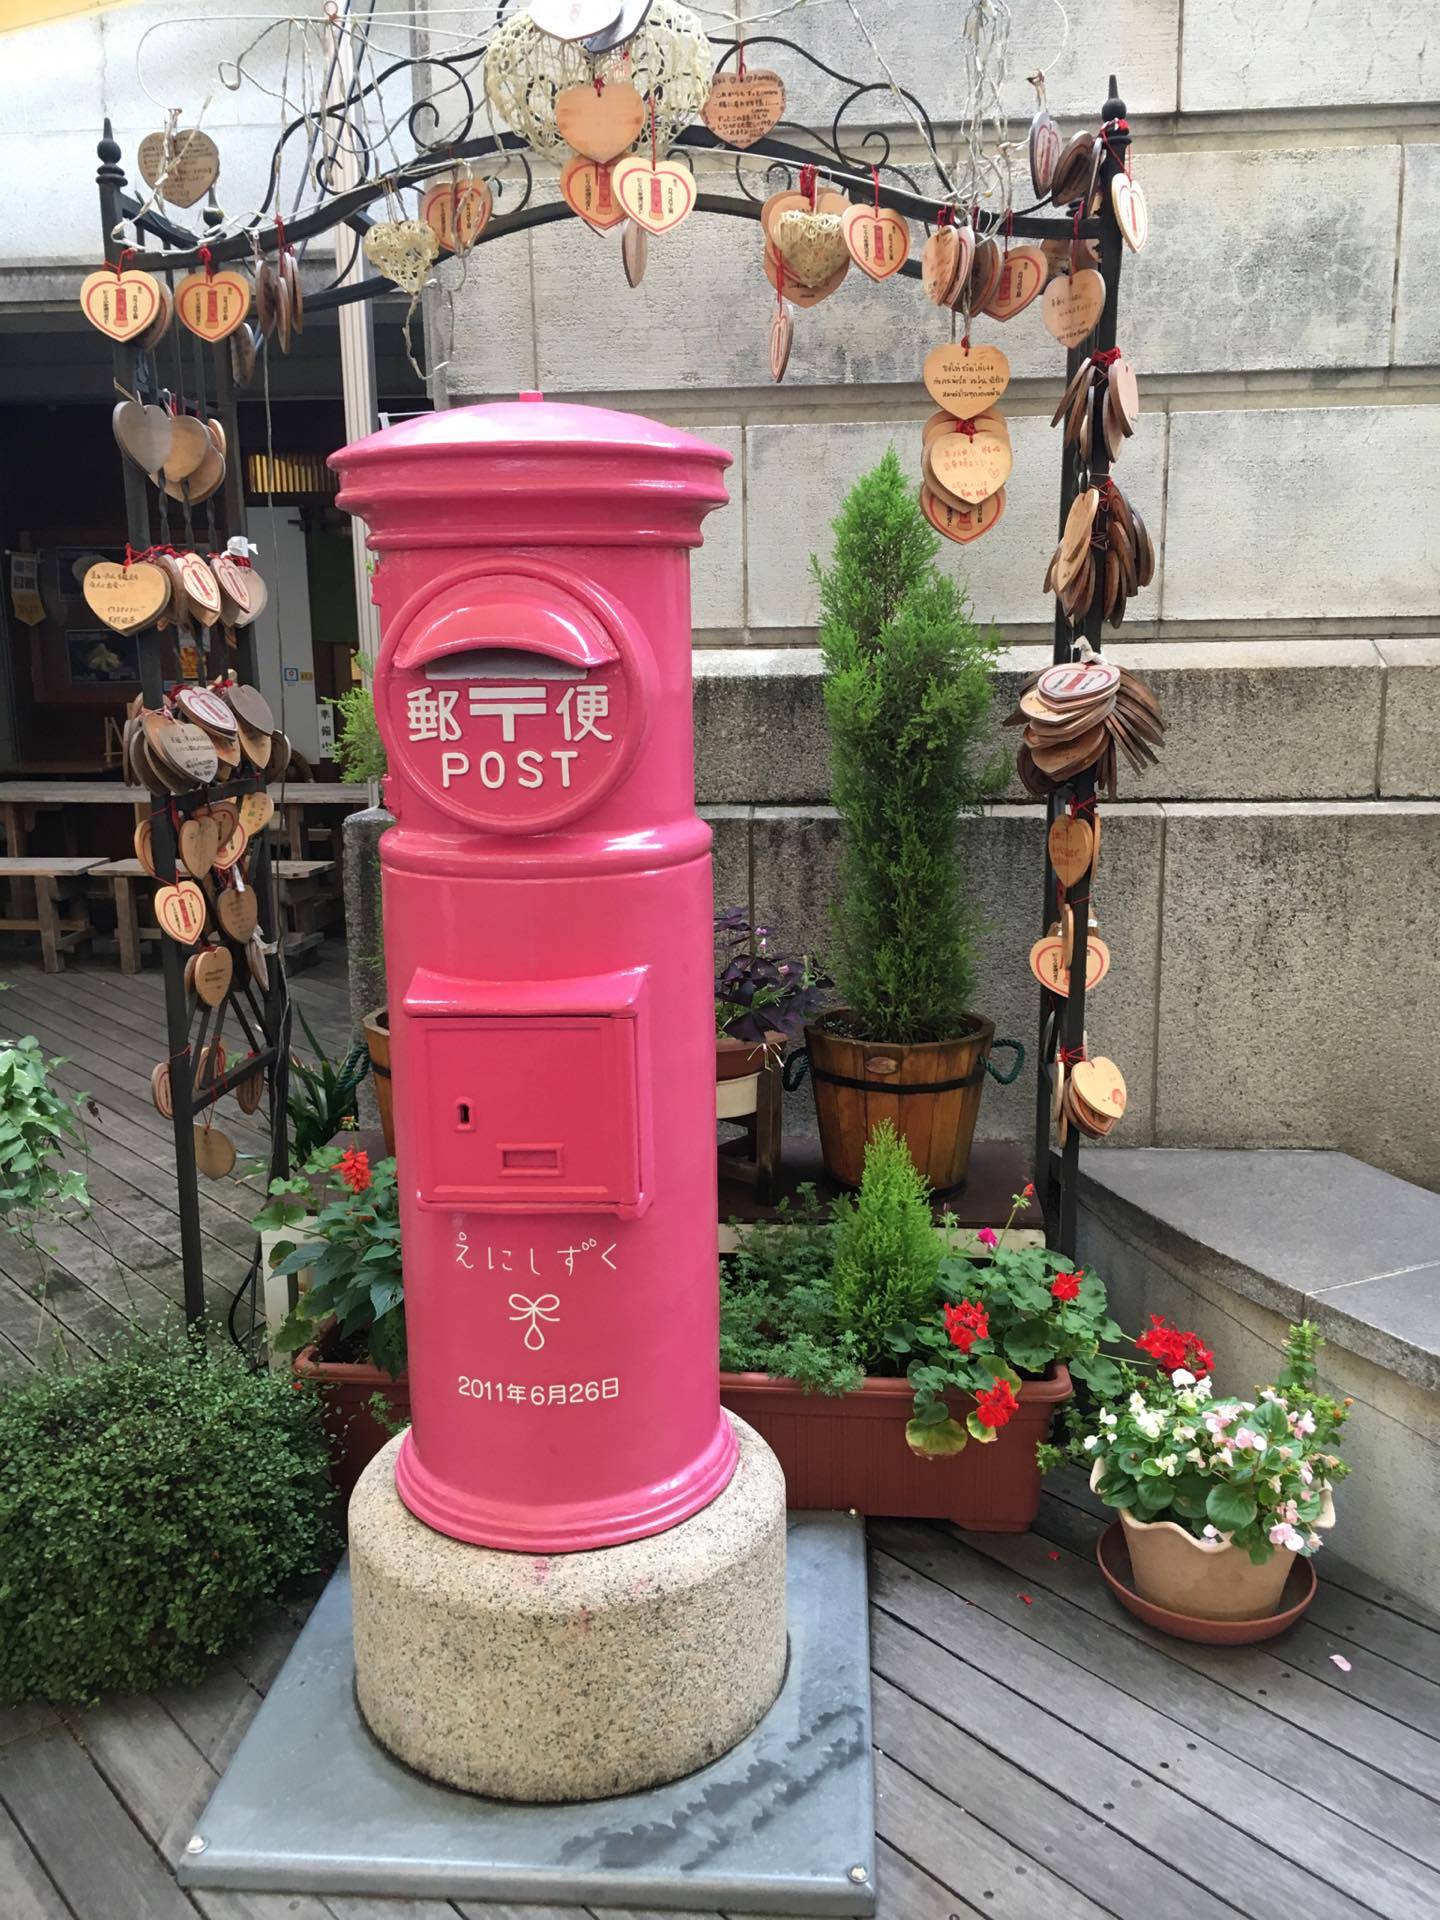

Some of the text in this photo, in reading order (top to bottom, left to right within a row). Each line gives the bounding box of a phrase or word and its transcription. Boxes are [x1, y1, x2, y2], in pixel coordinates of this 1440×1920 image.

[440, 750, 579, 789] POST
[455, 1231, 617, 1276] えにしずく
[457, 1375, 619, 1406] 2011年6月26日
